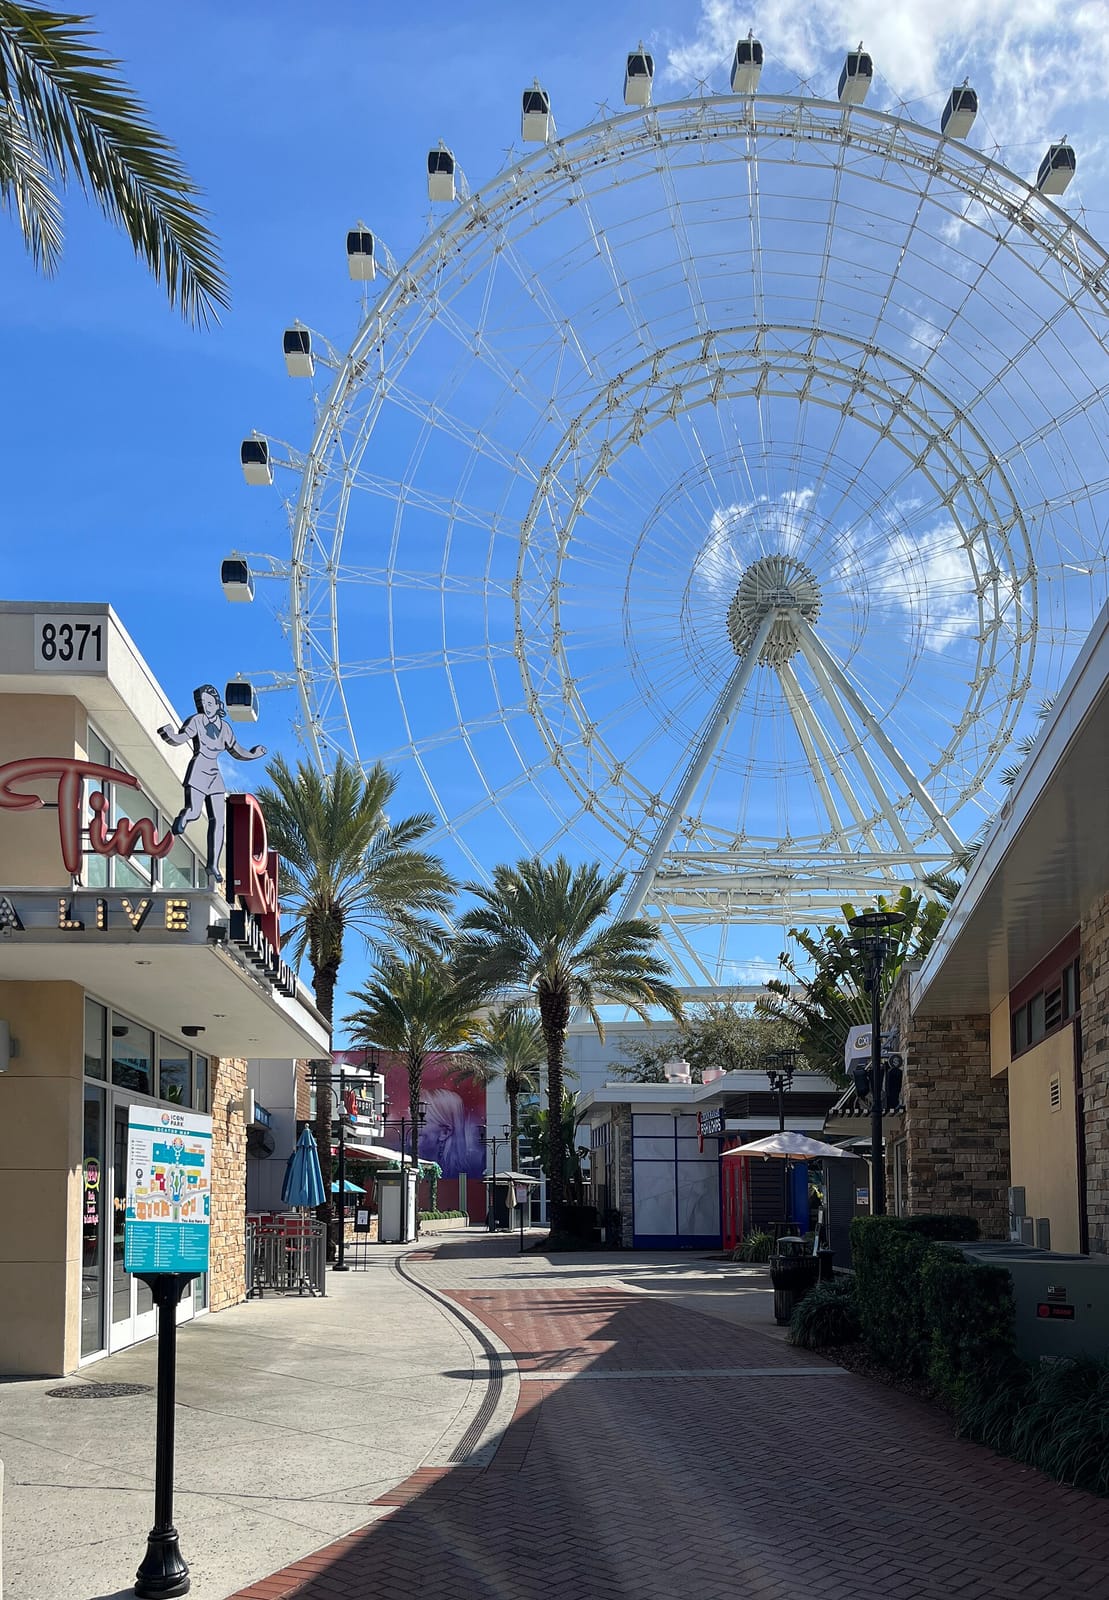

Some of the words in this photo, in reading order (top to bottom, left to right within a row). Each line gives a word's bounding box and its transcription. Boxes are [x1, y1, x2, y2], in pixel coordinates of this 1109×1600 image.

[41, 623, 102, 662] 8371
[0, 757, 175, 875] Tin
[58, 898, 191, 932] LIVE
[243, 910, 275, 971] MUSIC
